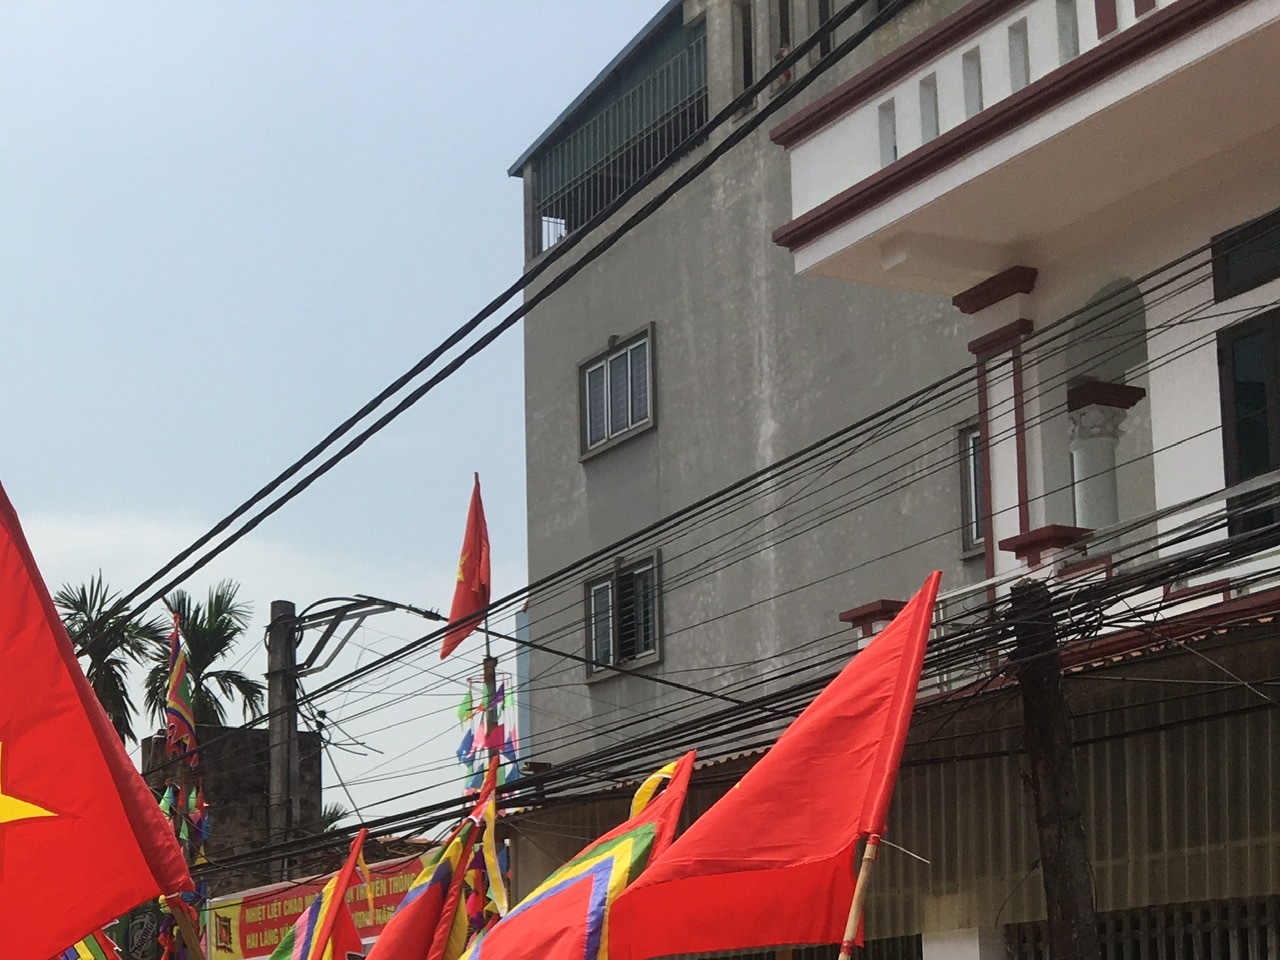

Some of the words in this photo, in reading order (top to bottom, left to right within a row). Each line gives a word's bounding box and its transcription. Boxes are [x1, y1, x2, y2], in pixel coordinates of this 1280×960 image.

[245, 903, 266, 924] NHIỆT
[267, 900, 282, 921] LIỆT
[283, 895, 303, 916] CHÀO
[246, 932, 258, 950] HAI
[260, 928, 279, 947] LÀNG
